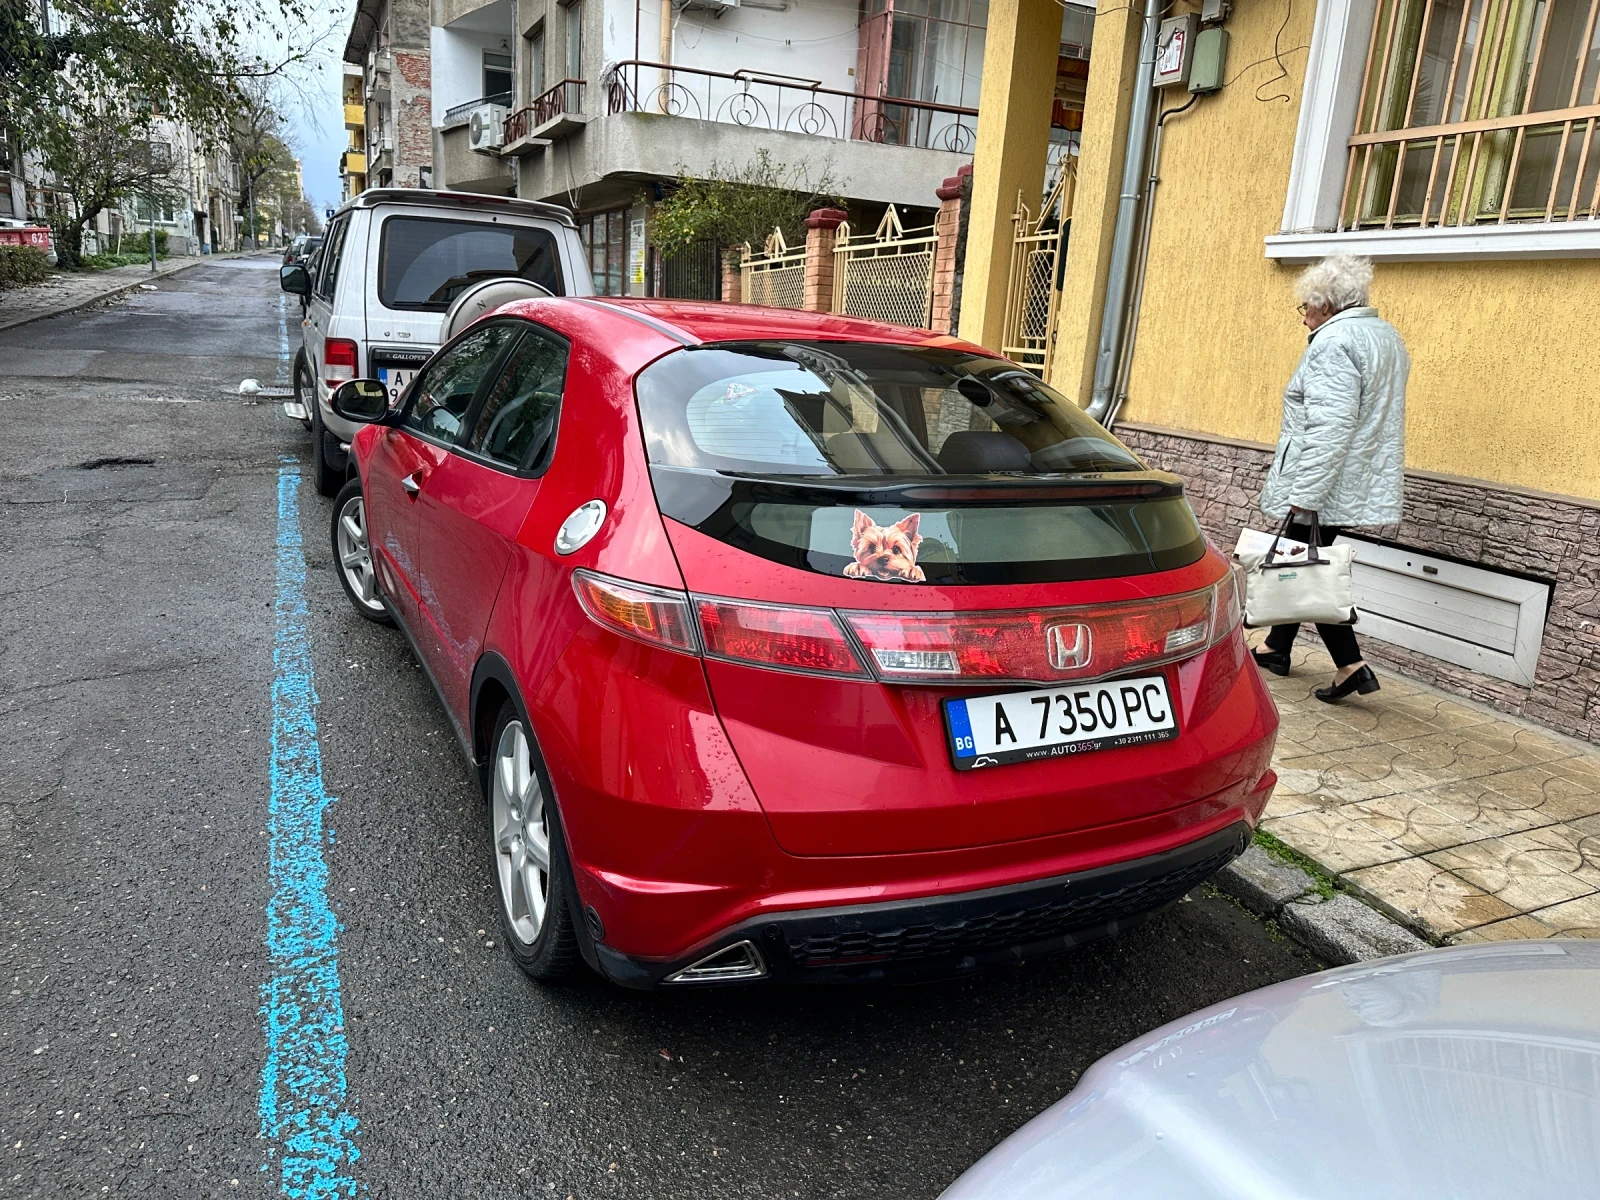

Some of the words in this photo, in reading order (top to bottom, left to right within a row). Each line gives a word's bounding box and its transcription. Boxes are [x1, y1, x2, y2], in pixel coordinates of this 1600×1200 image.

[394, 371, 403, 386] A
[995, 701, 1018, 746] A
[1030, 689, 1118, 740] 7350
[1119, 683, 1166, 727] PC
[955, 736, 974, 751] BG
[1114, 737, 1127, 746] +30
[1127, 734, 1143, 744] 2311
[1144, 732, 1157, 741] 111
[1157, 730, 1170, 739] 365
